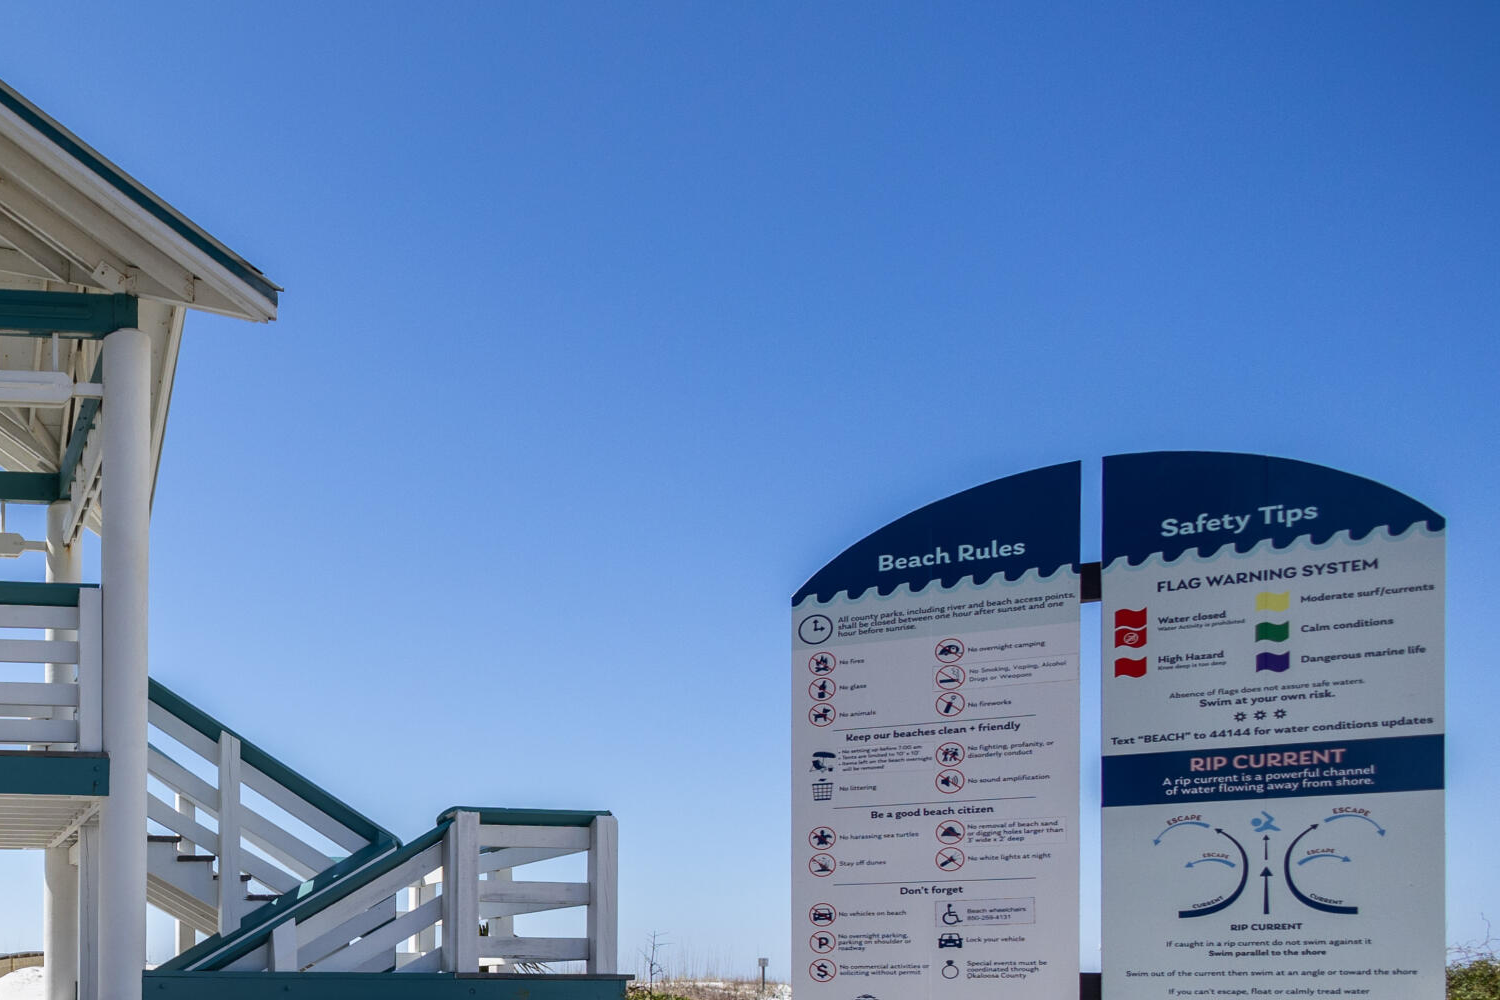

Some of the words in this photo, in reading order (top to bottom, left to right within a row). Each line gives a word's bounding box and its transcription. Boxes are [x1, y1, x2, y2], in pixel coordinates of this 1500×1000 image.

[1160, 512, 1250, 537] Safety
[1258, 504, 1318, 528] Tips
[878, 547, 951, 572] Beach
[958, 539, 1025, 561] Rules
[1157, 577, 1201, 592] FLAG
[1206, 566, 1297, 586] WARNING
[1302, 558, 1379, 577] SYSTEM
[1301, 590, 1354, 603] Moderate
[1357, 583, 1434, 596] surf/currents
[838, 615, 848, 623] All
[851, 613, 878, 623] county
[907, 606, 945, 615] including
[968, 601, 985, 610] and
[987, 599, 1012, 608] beach
[1158, 614, 1190, 624] Water
[1192, 611, 1226, 621] closed
[838, 622, 857, 630] shall
[871, 618, 896, 627] closed
[898, 616, 932, 625] between
[953, 611, 971, 619] hour
[1301, 623, 1330, 633] Calm
[1333, 618, 1394, 630] conditions
[859, 627, 883, 635] before
[1158, 654, 1182, 664] High
[1186, 650, 1224, 660] Hazard
[1301, 651, 1361, 664] Dangerous
[1364, 649, 1405, 658] marine
[1408, 646, 1426, 654] life
[1169, 690, 1204, 699] Absence
[1207, 688, 1216, 696] of
[1218, 687, 1239, 696] flags
[1281, 683, 1310, 691] assure
[1312, 680, 1330, 688] safe
[1200, 698, 1232, 708] Swim
[1236, 697, 1248, 705] at
[1251, 696, 1276, 705] your
[1280, 692, 1306, 700] own
[1310, 690, 1336, 700] risk.
[846, 734, 871, 742] Keep
[894, 729, 935, 738] beaches
[978, 721, 1020, 731] friendly
[1111, 736, 1136, 745] Text
[1194, 732, 1206, 740] to
[1209, 728, 1251, 738] 44144
[1254, 726, 1271, 736] for
[1274, 724, 1309, 734] water
[1313, 719, 1378, 732] conditions
[1382, 716, 1434, 729] updates
[1190, 756, 1228, 772] RIP
[1233, 748, 1347, 769] CURRENT
[1162, 777, 1172, 786] A
[1175, 777, 1191, 787] rip
[1194, 774, 1239, 784] current
[1242, 772, 1252, 781] is
[1266, 768, 1320, 781] powerful
[1323, 765, 1374, 776] channel
[1166, 786, 1178, 795] of
[1181, 784, 1216, 794] water
[1219, 782, 1264, 794] flowing
[1267, 781, 1299, 792] away
[1302, 778, 1333, 788] from
[1336, 776, 1374, 786] shore.
[895, 808, 920, 819] good
[923, 807, 954, 816] beach
[958, 806, 994, 814] citizen
[1166, 814, 1202, 826] ESCAPE
[1332, 807, 1371, 816] ESCAPE
[932, 886, 963, 896] forget
[1310, 893, 1343, 905] CURRENT
[1192, 896, 1224, 909] CURRENT
[1235, 949, 1269, 958] parallel
[1285, 988, 1314, 996] calmly
